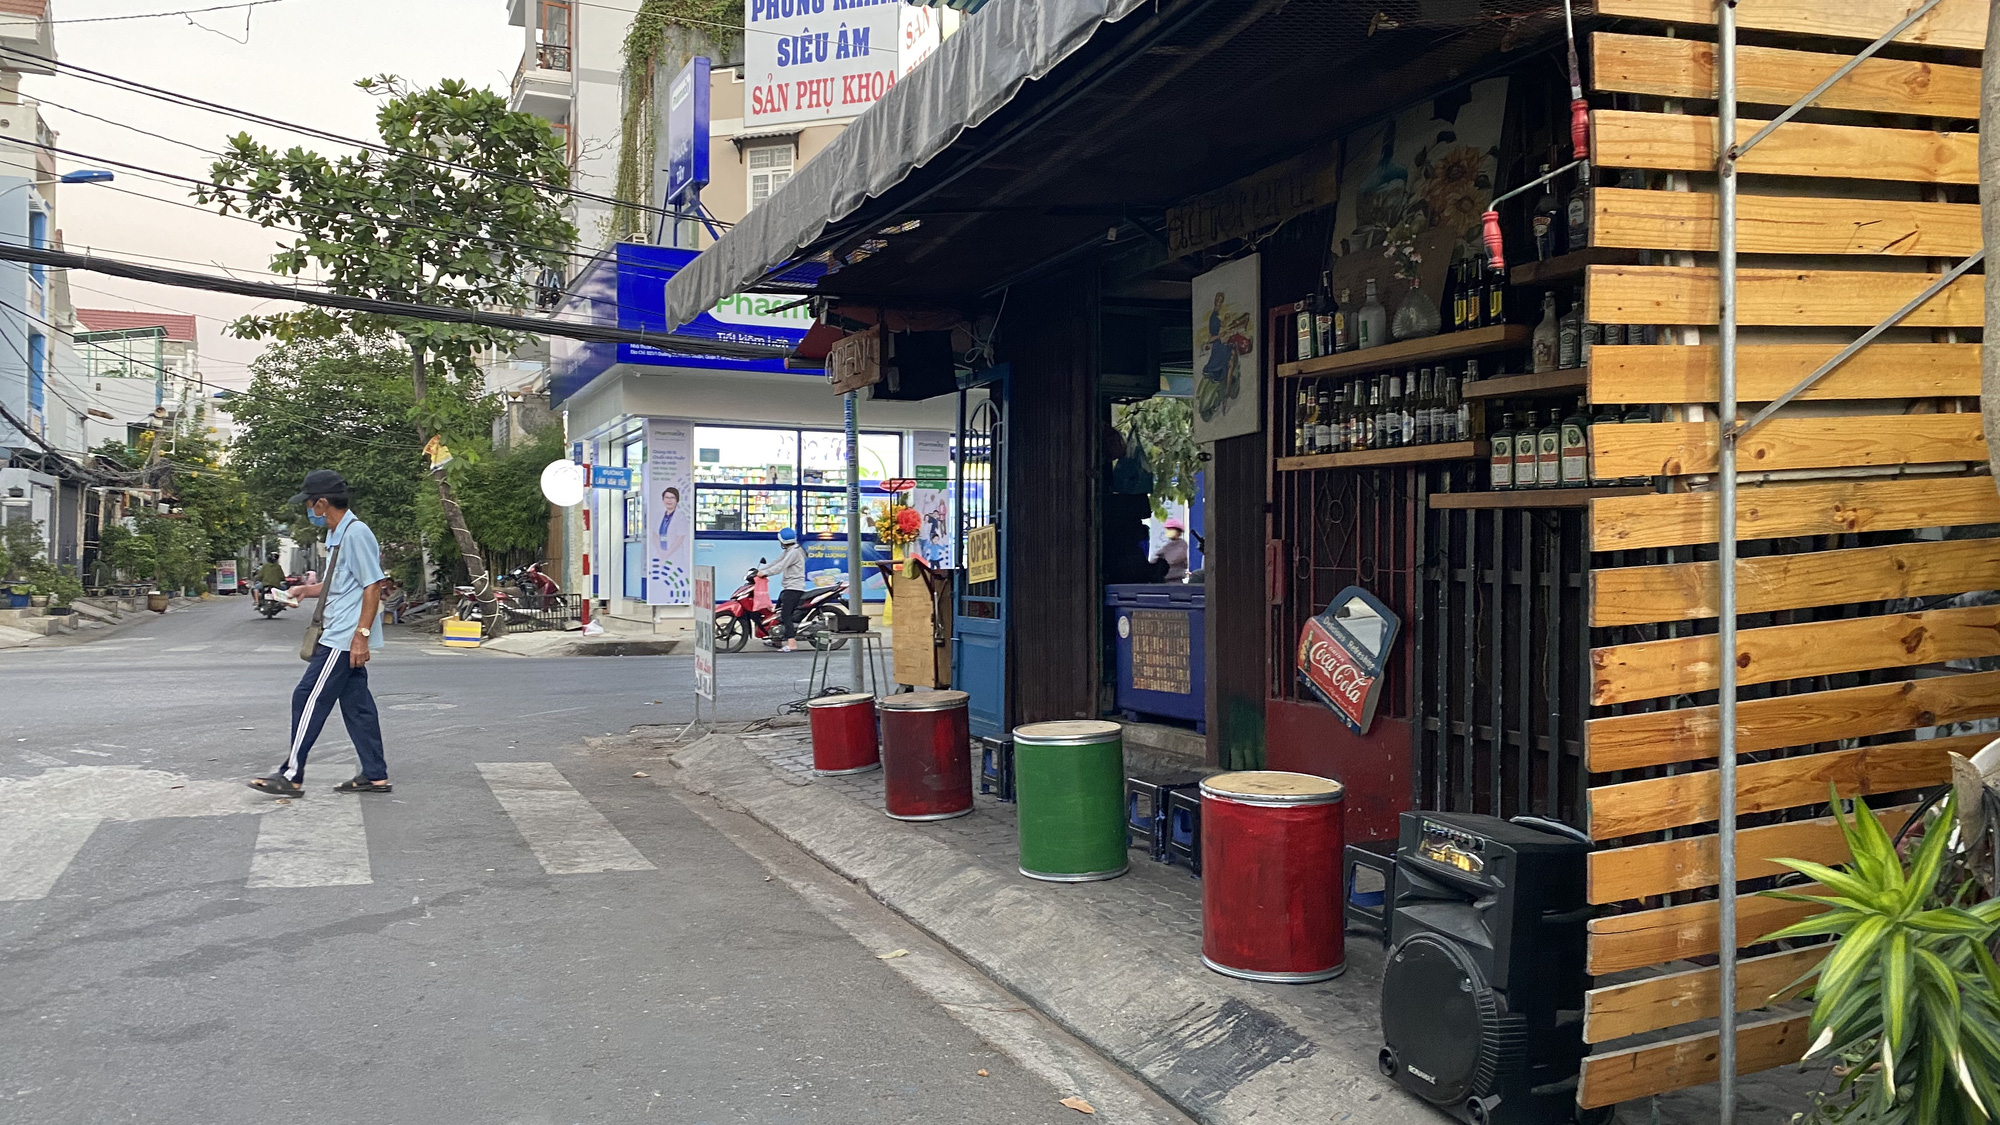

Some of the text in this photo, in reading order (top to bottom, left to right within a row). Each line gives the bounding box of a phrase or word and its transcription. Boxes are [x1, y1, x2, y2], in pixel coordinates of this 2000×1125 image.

[777, 22, 870, 67] SIÊU ÂM
[752, 70, 895, 115] SẢN PHỤ KHOA
[971, 531, 994, 564] OPEN
[1323, 616, 1375, 671] Delicious Refreshing
